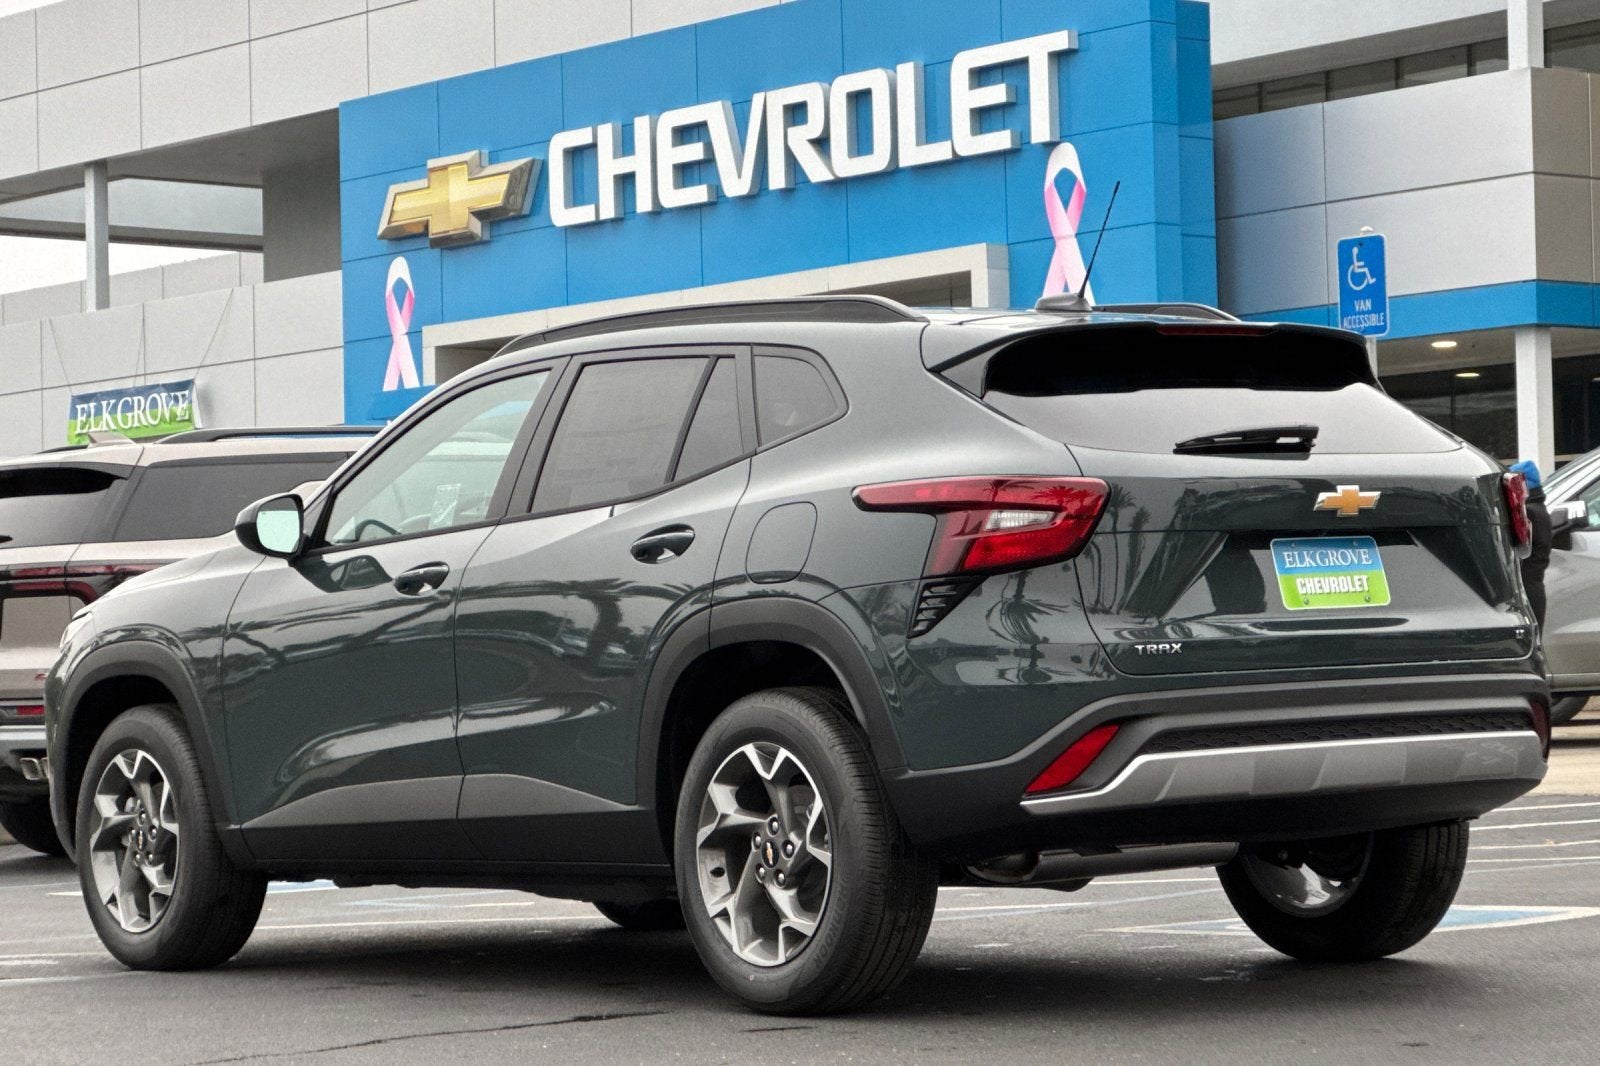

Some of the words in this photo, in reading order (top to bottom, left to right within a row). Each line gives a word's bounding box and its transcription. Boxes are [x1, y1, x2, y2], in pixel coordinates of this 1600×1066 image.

[548, 29, 1078, 227] CHEVROLET
[1353, 298, 1372, 312] VAN
[1343, 312, 1385, 329] ACCESSIBLE
[1295, 575, 1370, 595] CHEVROLET
[1133, 642, 1183, 656] TRAX
